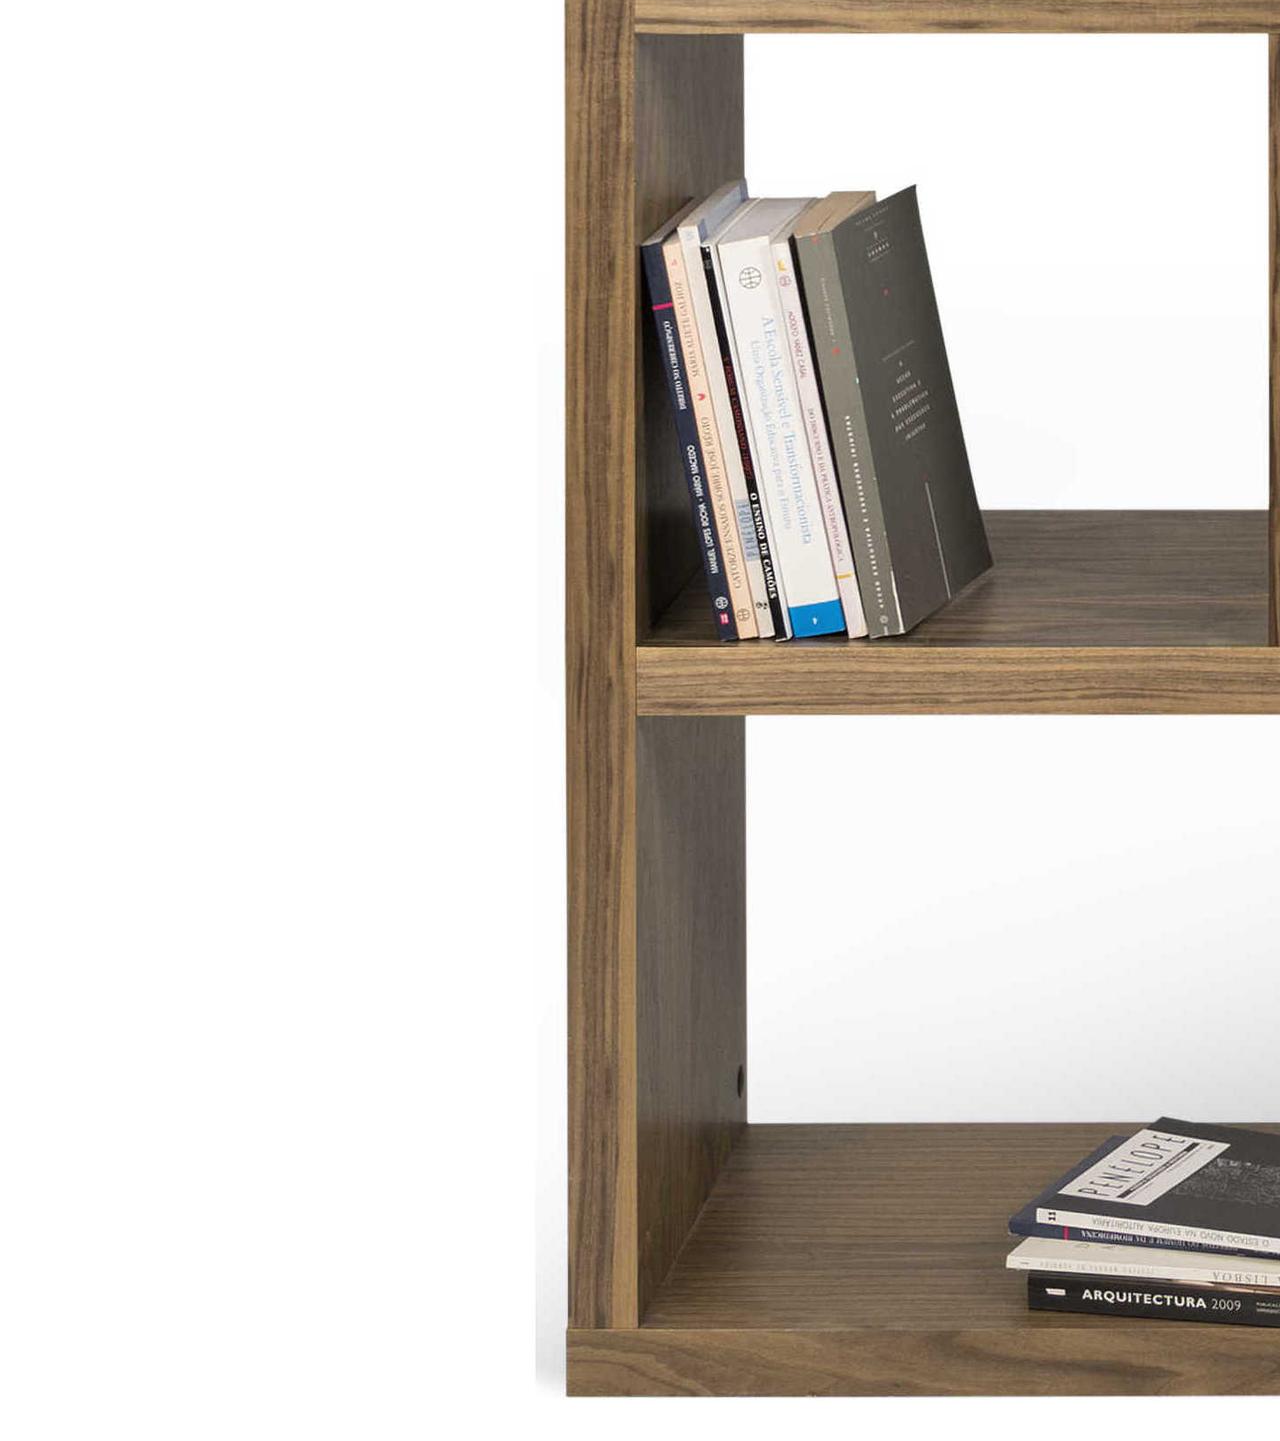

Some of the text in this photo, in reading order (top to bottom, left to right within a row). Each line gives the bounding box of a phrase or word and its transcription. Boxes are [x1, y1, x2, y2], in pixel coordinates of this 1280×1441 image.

[762, 317, 773, 327] A
[764, 329, 782, 367] Escola
[698, 503, 708, 526] ROCHA
[703, 528, 712, 547] LOPES
[749, 492, 780, 598] O ENSINO DE CAMÕES
[1081, 1230, 1133, 1241] BIOMEDICINA
[1148, 1224, 1181, 1236] EUROPA
[1184, 1228, 1196, 1238] NA
[1198, 1231, 1223, 1241] NOVO
[1226, 1233, 1258, 1246] ESTADO
[1210, 1272, 1267, 1285] LISBOA
[1083, 1290, 1241, 1311] ARQUITECTURA 2009
